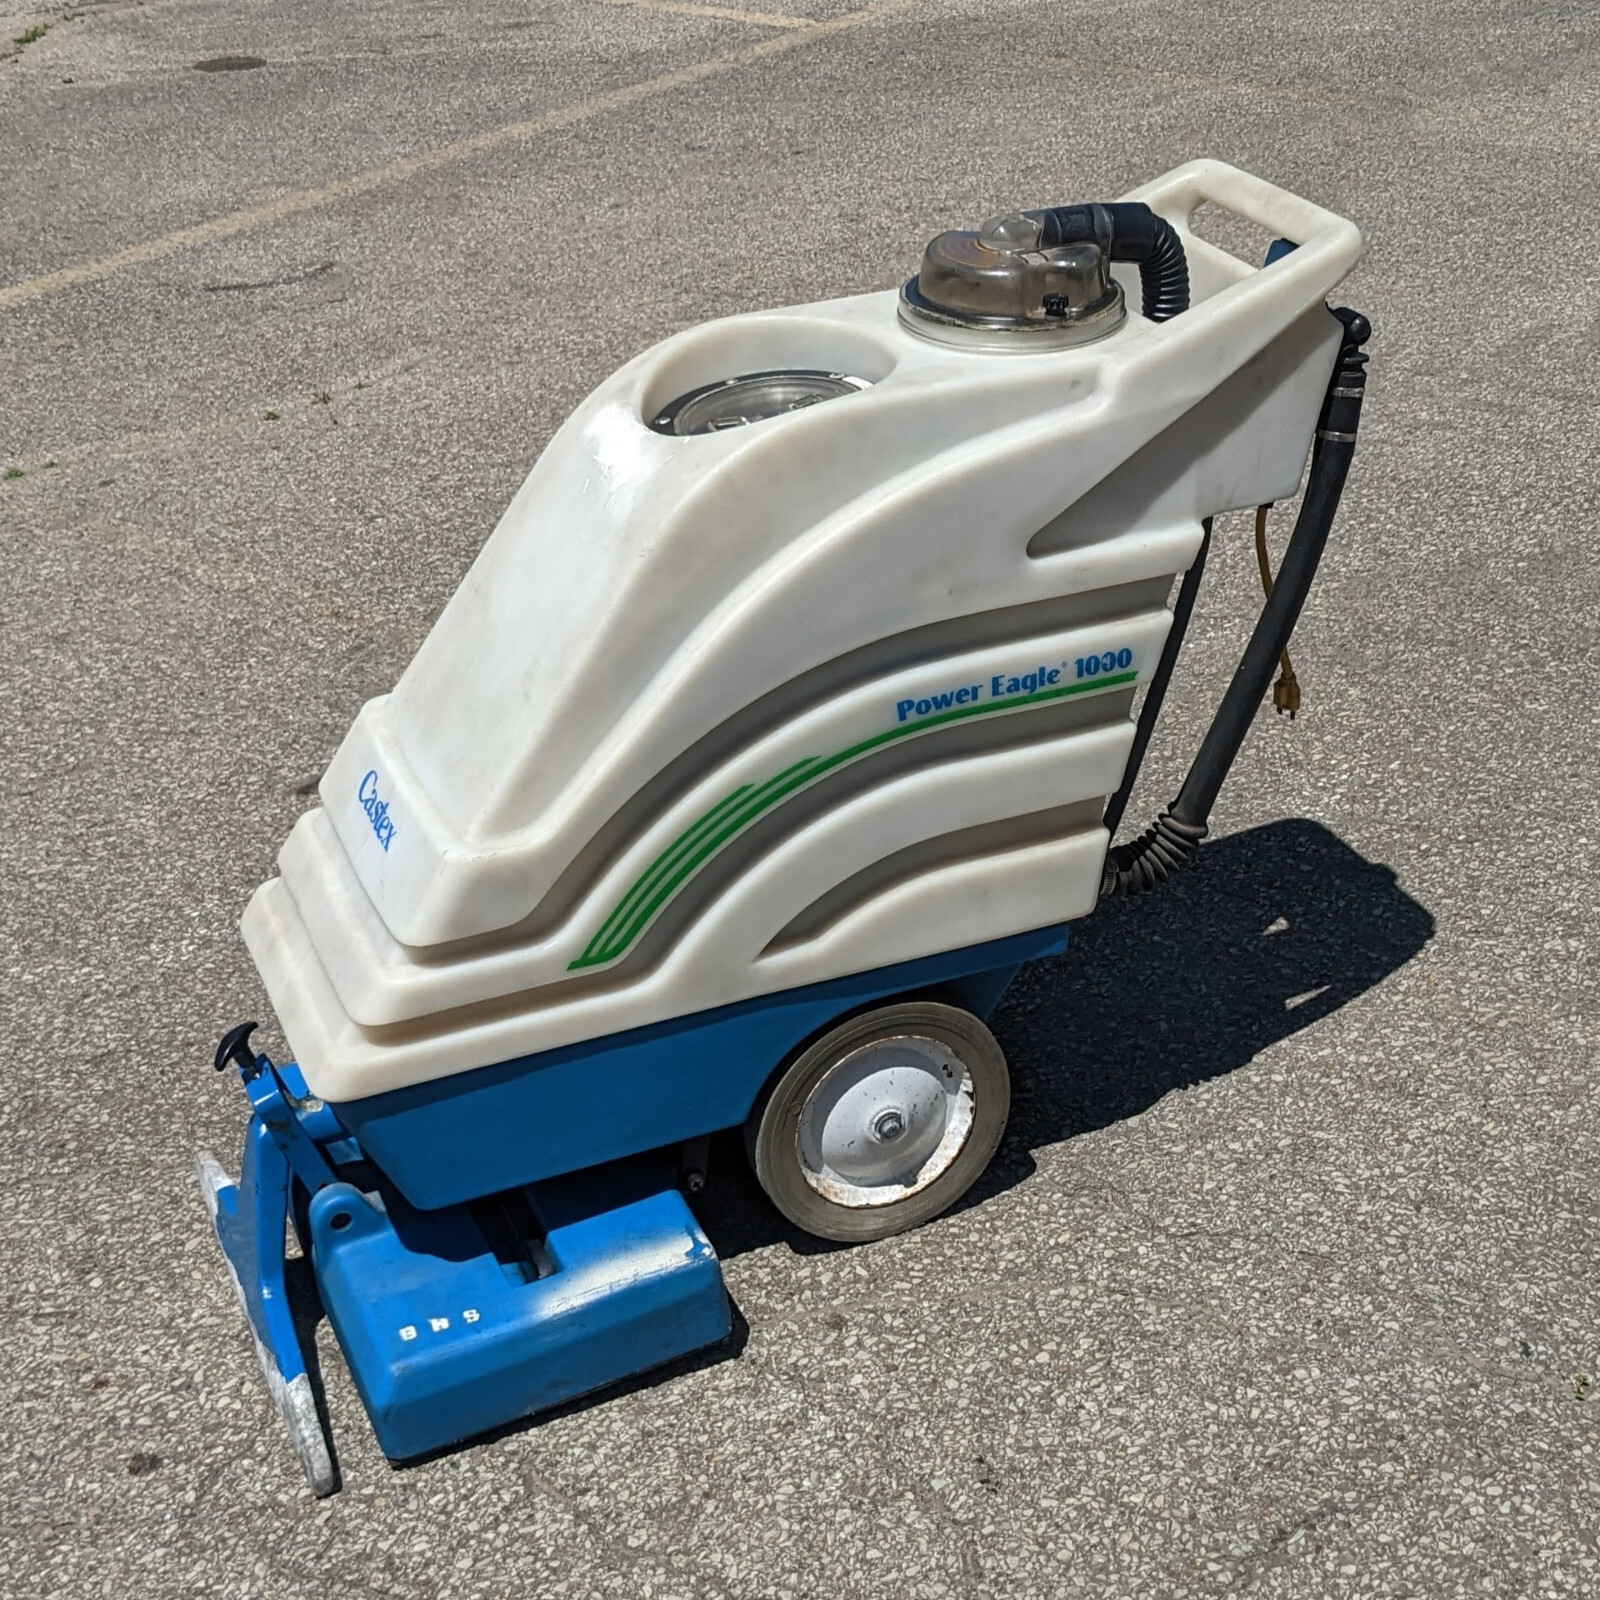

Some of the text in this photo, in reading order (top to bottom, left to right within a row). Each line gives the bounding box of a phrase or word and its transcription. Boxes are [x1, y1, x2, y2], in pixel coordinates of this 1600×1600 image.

[896, 684, 983, 722] Power
[1074, 648, 1133, 679] 1000
[358, 769, 397, 853] Castex
